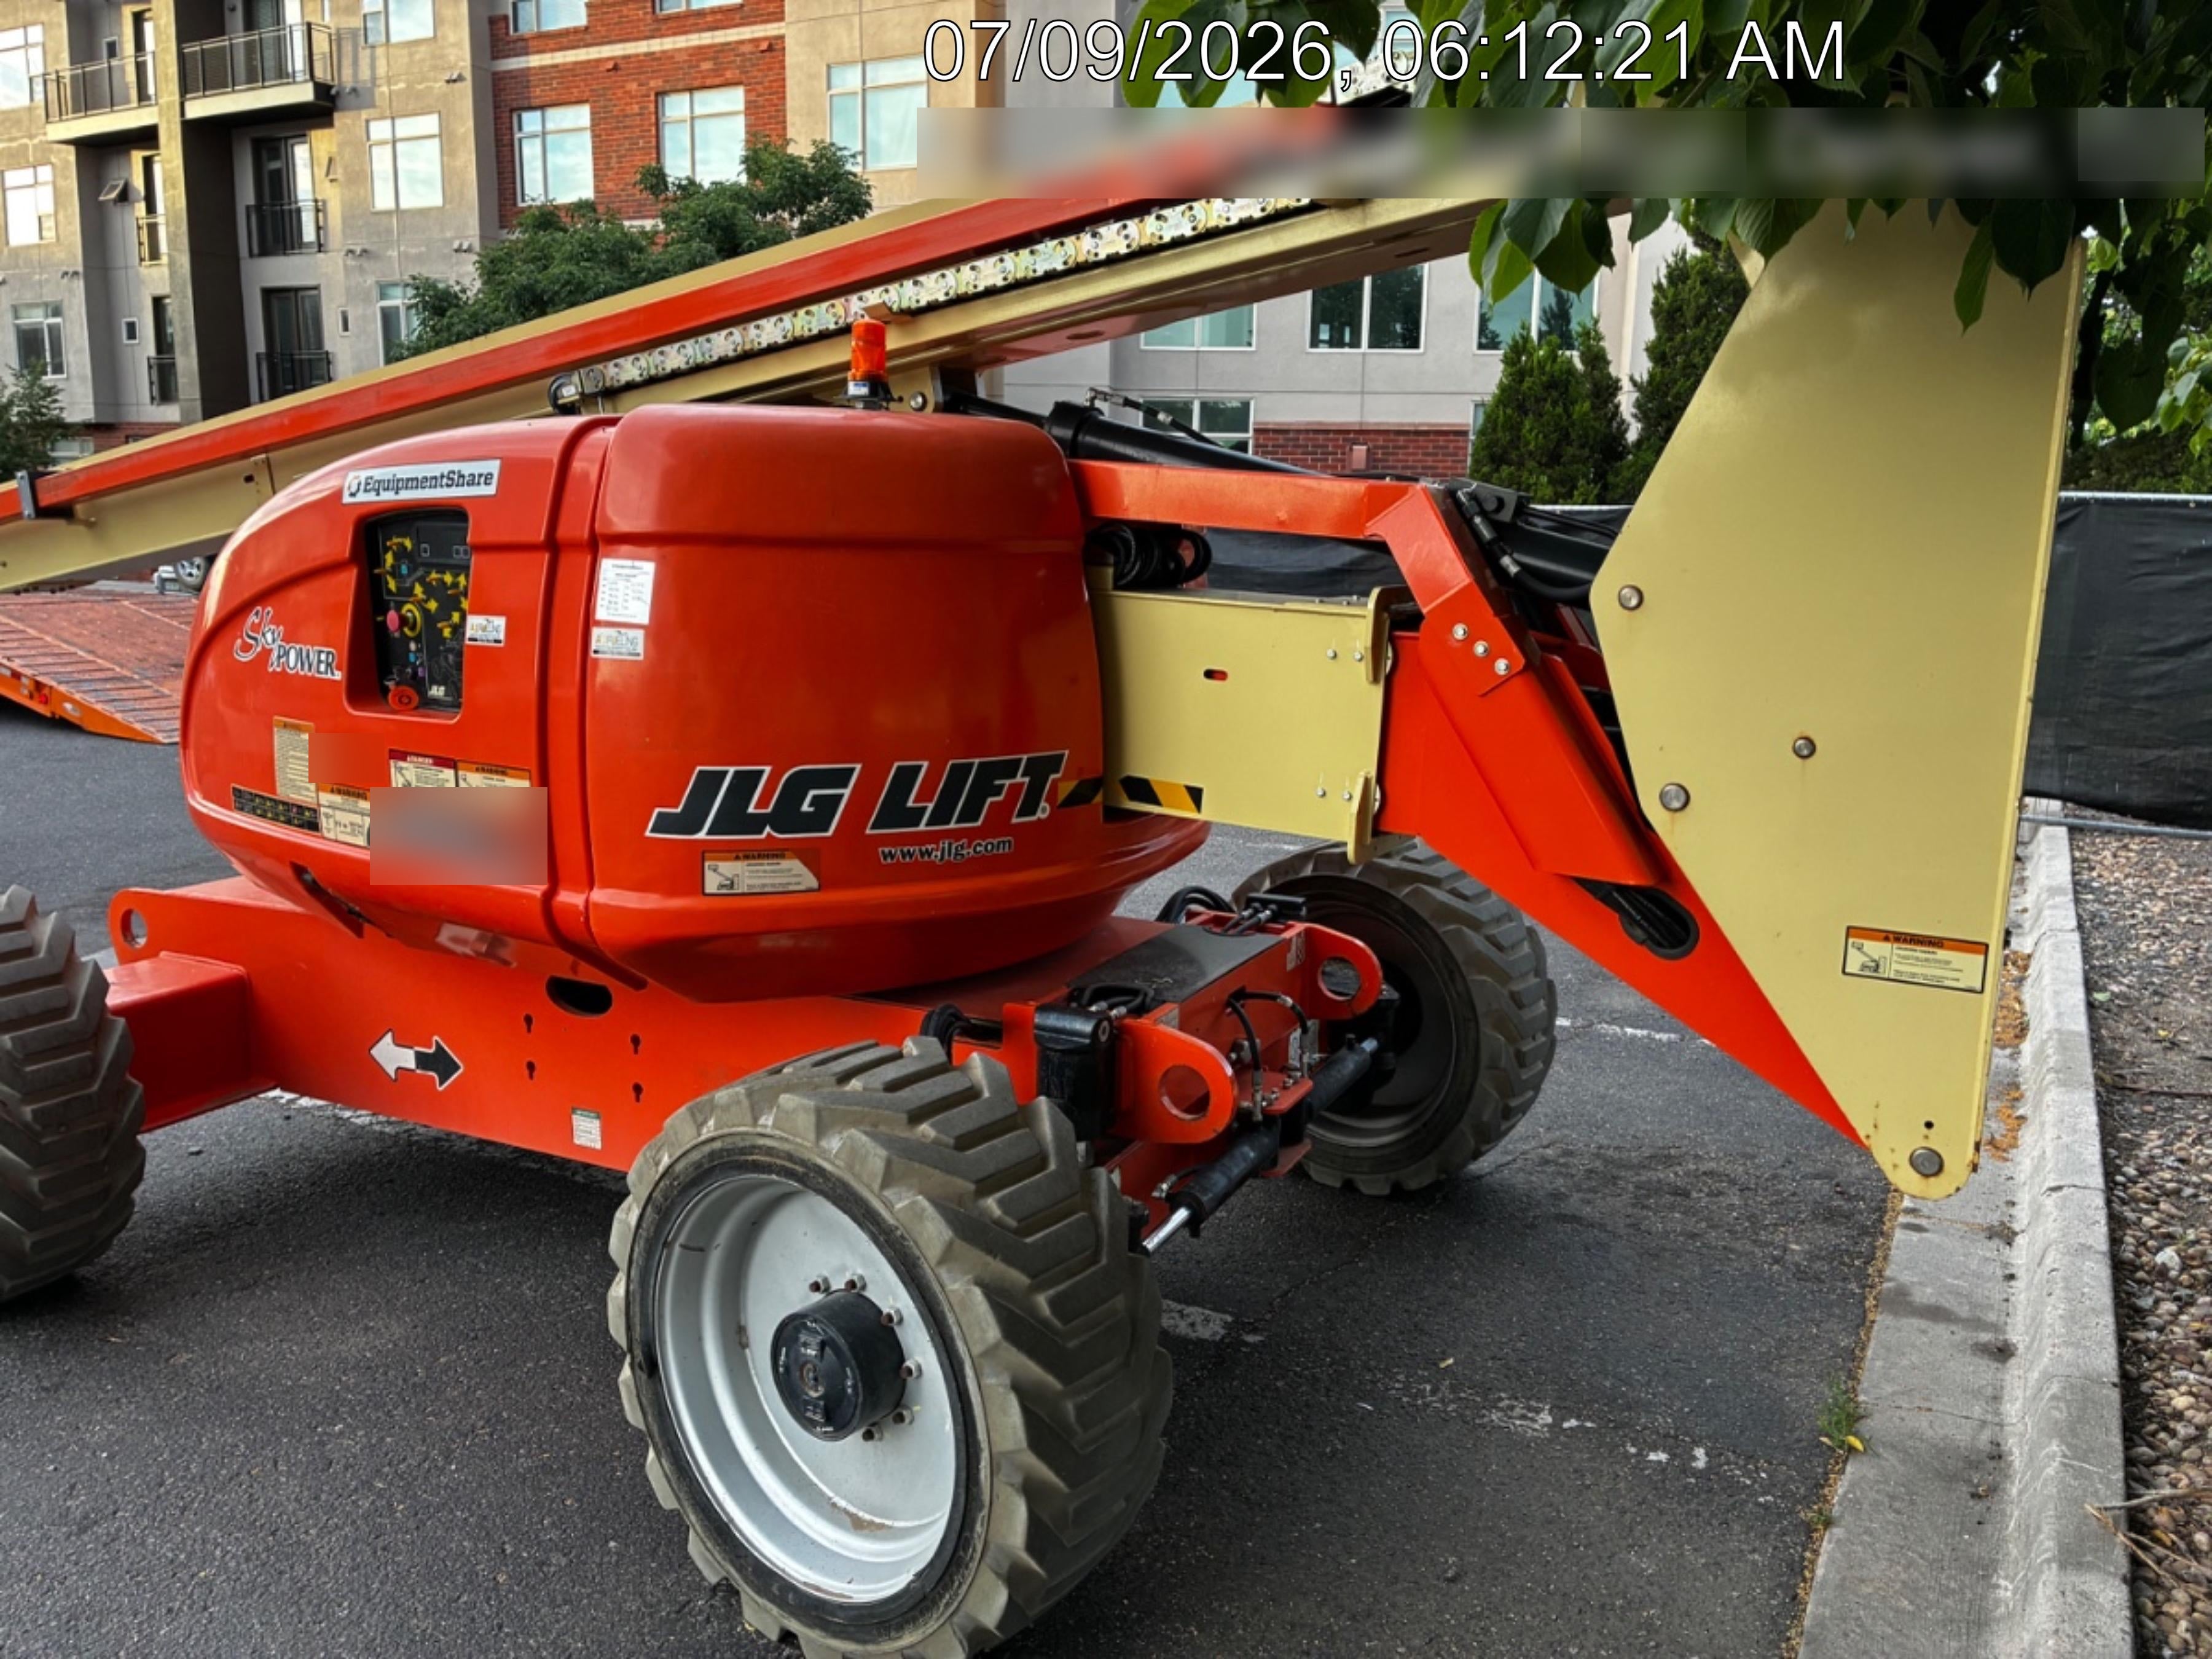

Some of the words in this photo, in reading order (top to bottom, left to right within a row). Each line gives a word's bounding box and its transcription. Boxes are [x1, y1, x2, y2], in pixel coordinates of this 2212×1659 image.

[363, 469, 495, 496] EquipmentShare
[233, 606, 284, 673] Sky
[275, 643, 340, 680] POWER
[645, 763, 862, 840] JLG
[865, 750, 1069, 834] LIFT
[879, 837, 1014, 863] www.jlg.com
[1892, 934, 1944, 948] WARNING
